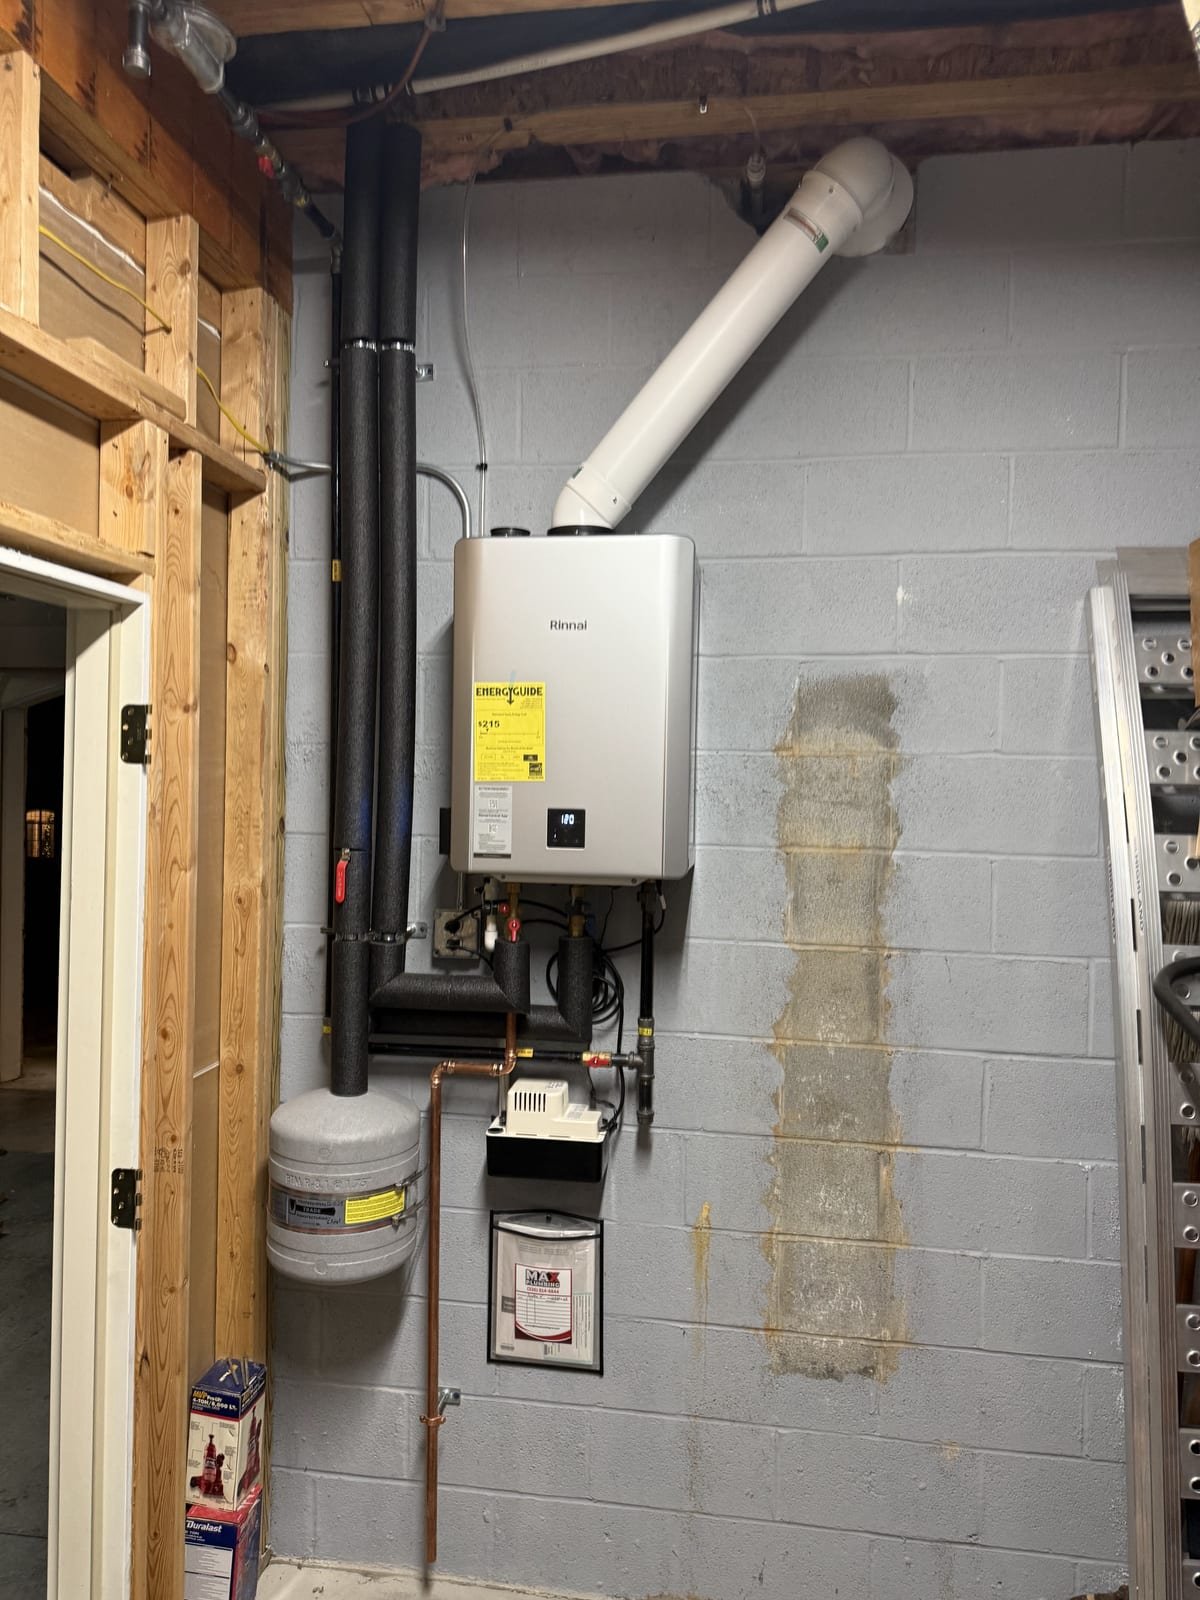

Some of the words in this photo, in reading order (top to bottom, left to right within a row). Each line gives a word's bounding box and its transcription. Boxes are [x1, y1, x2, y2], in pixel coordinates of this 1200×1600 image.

[550, 619, 588, 631] Rinnai
[525, 1269, 560, 1282] MAX
[186, 1520, 222, 1533] Duralast
